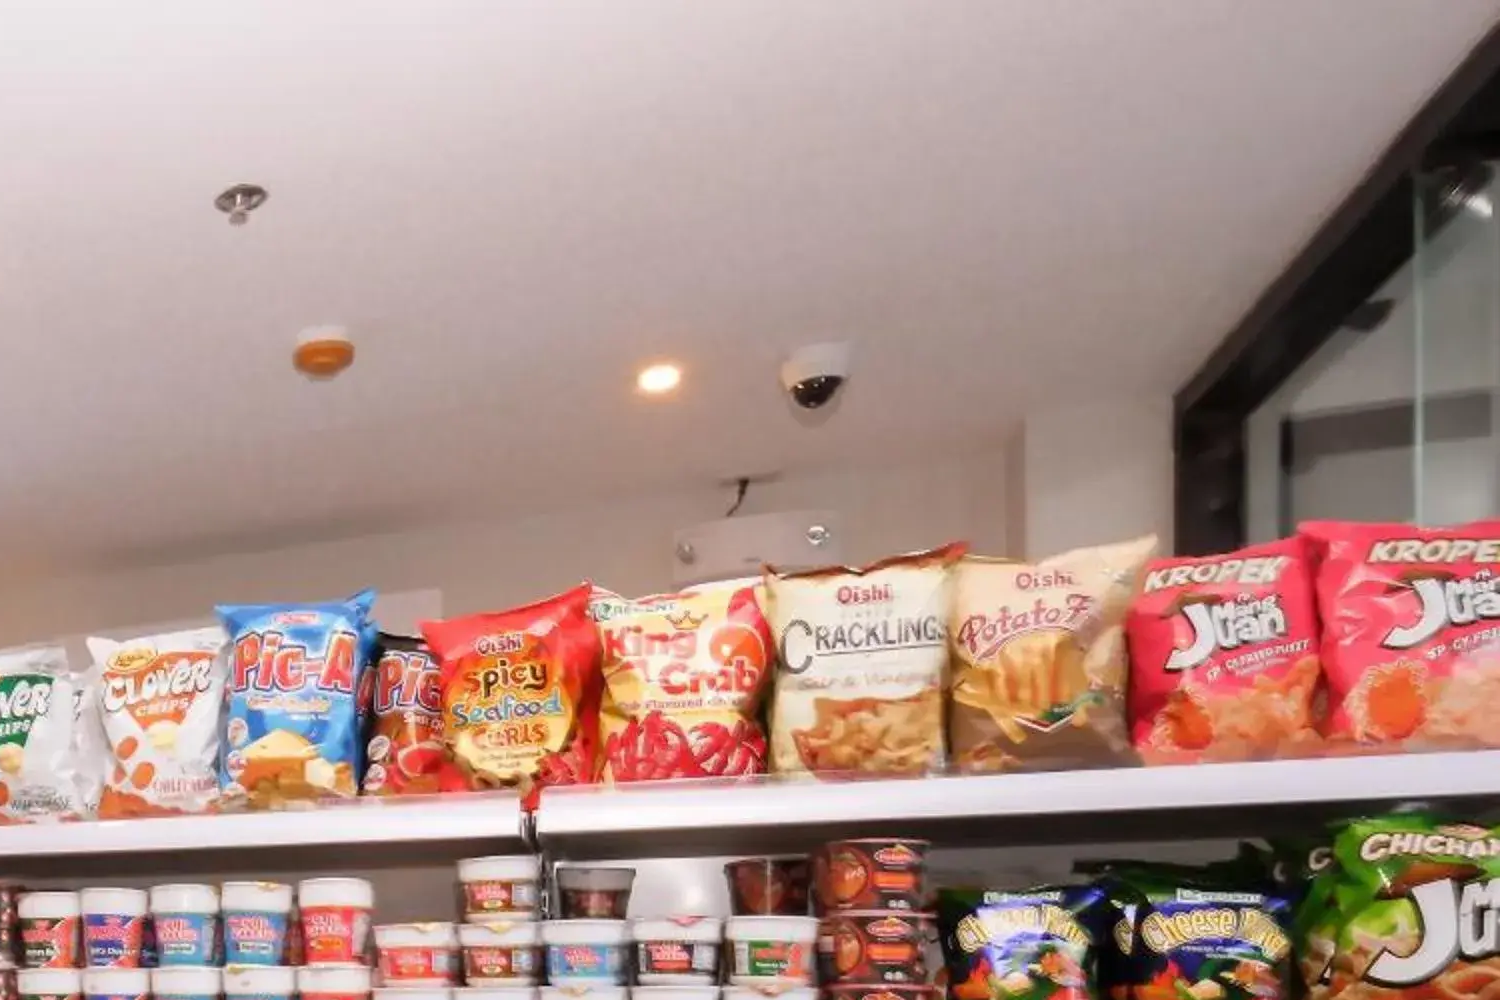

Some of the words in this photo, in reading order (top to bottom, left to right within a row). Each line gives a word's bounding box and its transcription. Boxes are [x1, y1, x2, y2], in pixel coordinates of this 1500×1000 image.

[1367, 539, 1500, 563] KROPE
[1015, 569, 1075, 591] Oishi
[1144, 555, 1286, 592] KROPEK
[837, 583, 891, 605] Oishi
[1380, 577, 1500, 649] Jua
[958, 598, 1060, 654] Potato
[102, 656, 212, 712] CLOVER
[462, 660, 548, 698] Spicy
[658, 659, 759, 695] Crab
[451, 687, 563, 728] Seafood
[1142, 907, 1236, 953] Cheese
